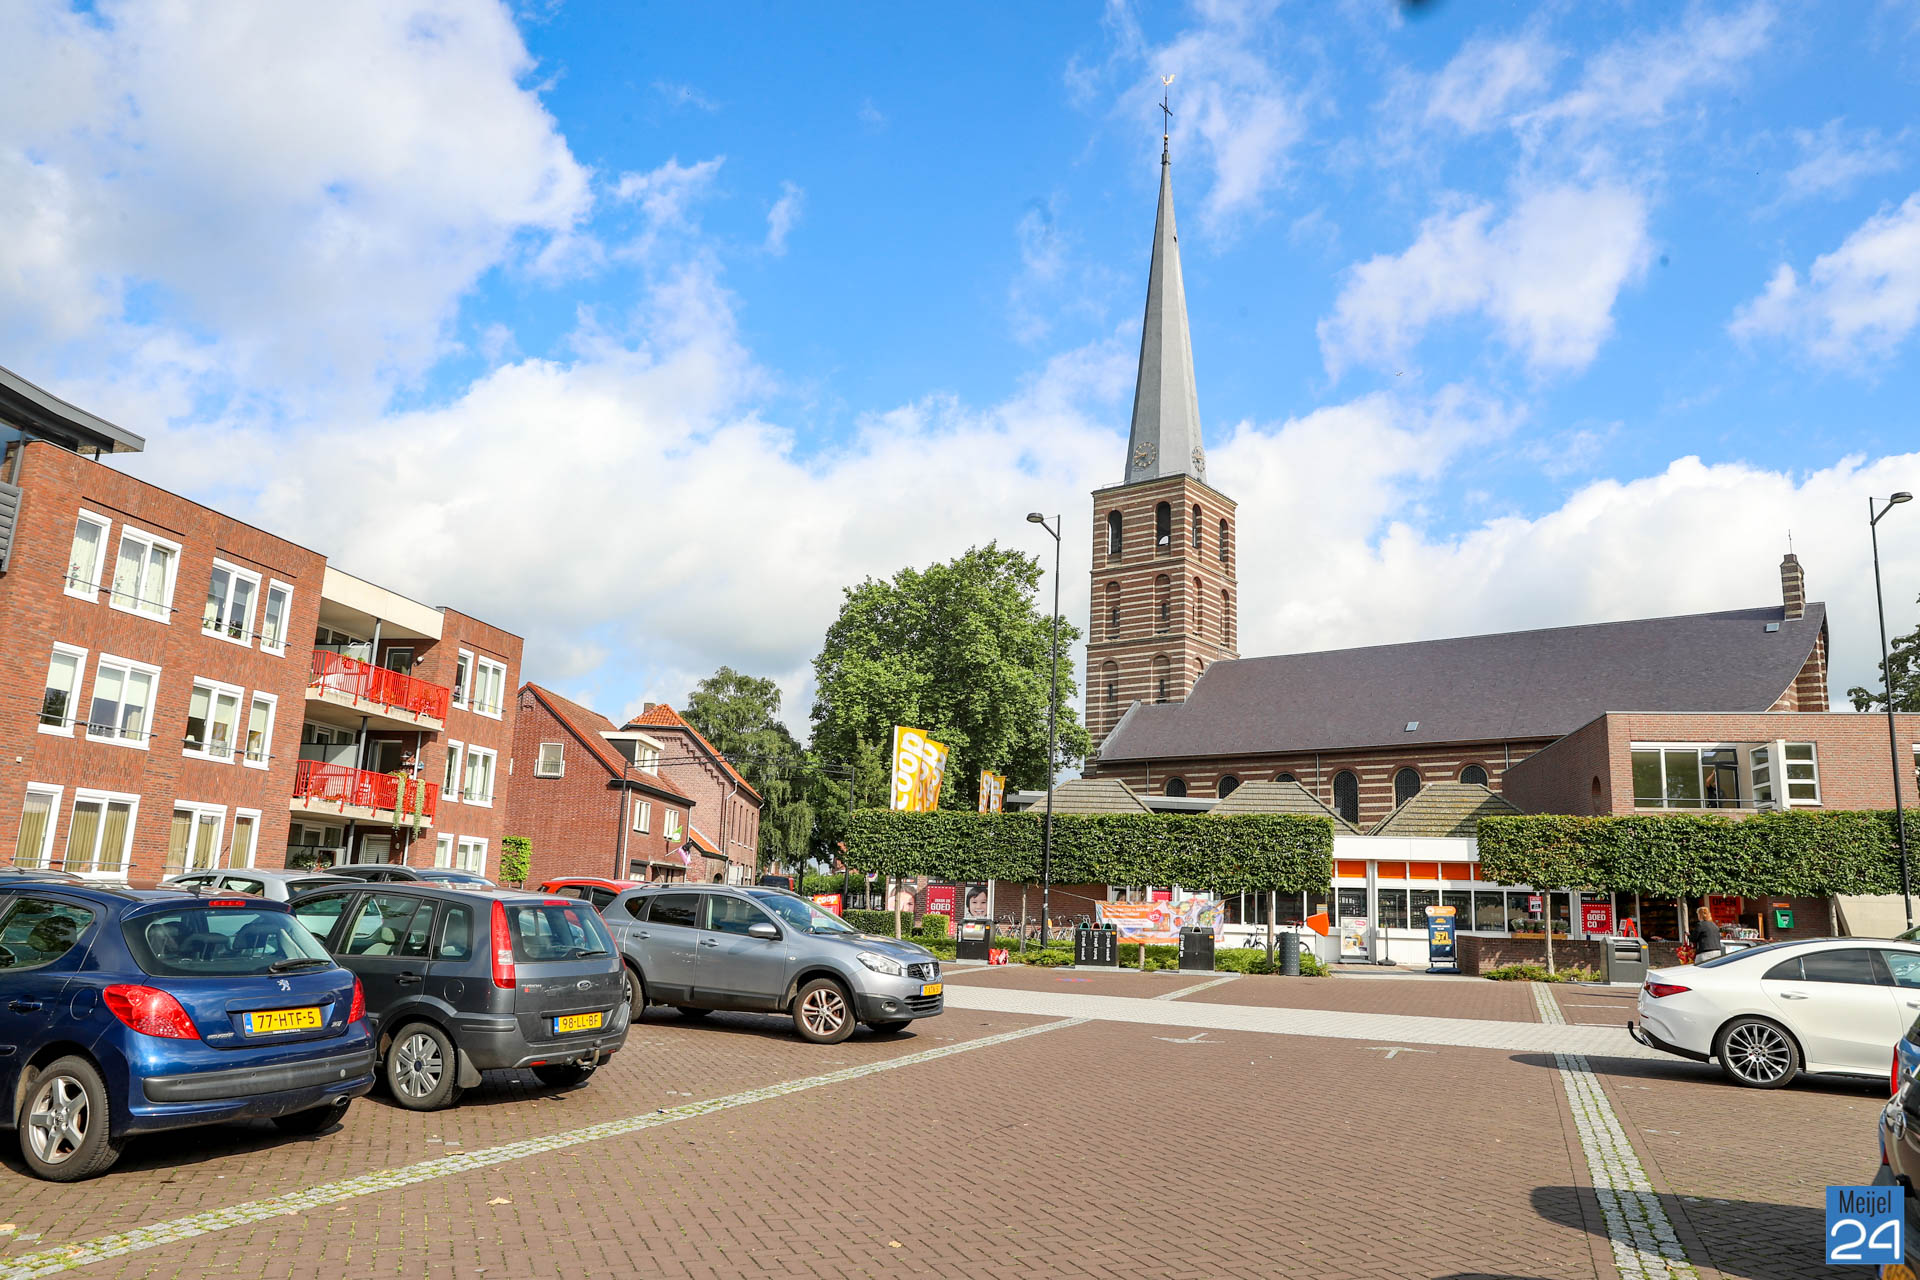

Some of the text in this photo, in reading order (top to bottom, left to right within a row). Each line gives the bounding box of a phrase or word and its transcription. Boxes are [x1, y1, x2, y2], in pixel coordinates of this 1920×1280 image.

[816, 895, 838, 905] coop
[930, 903, 951, 911] GOED
[257, 1011, 315, 1029] 77-HTF-5
[562, 1014, 599, 1029] 98-LL-BF
